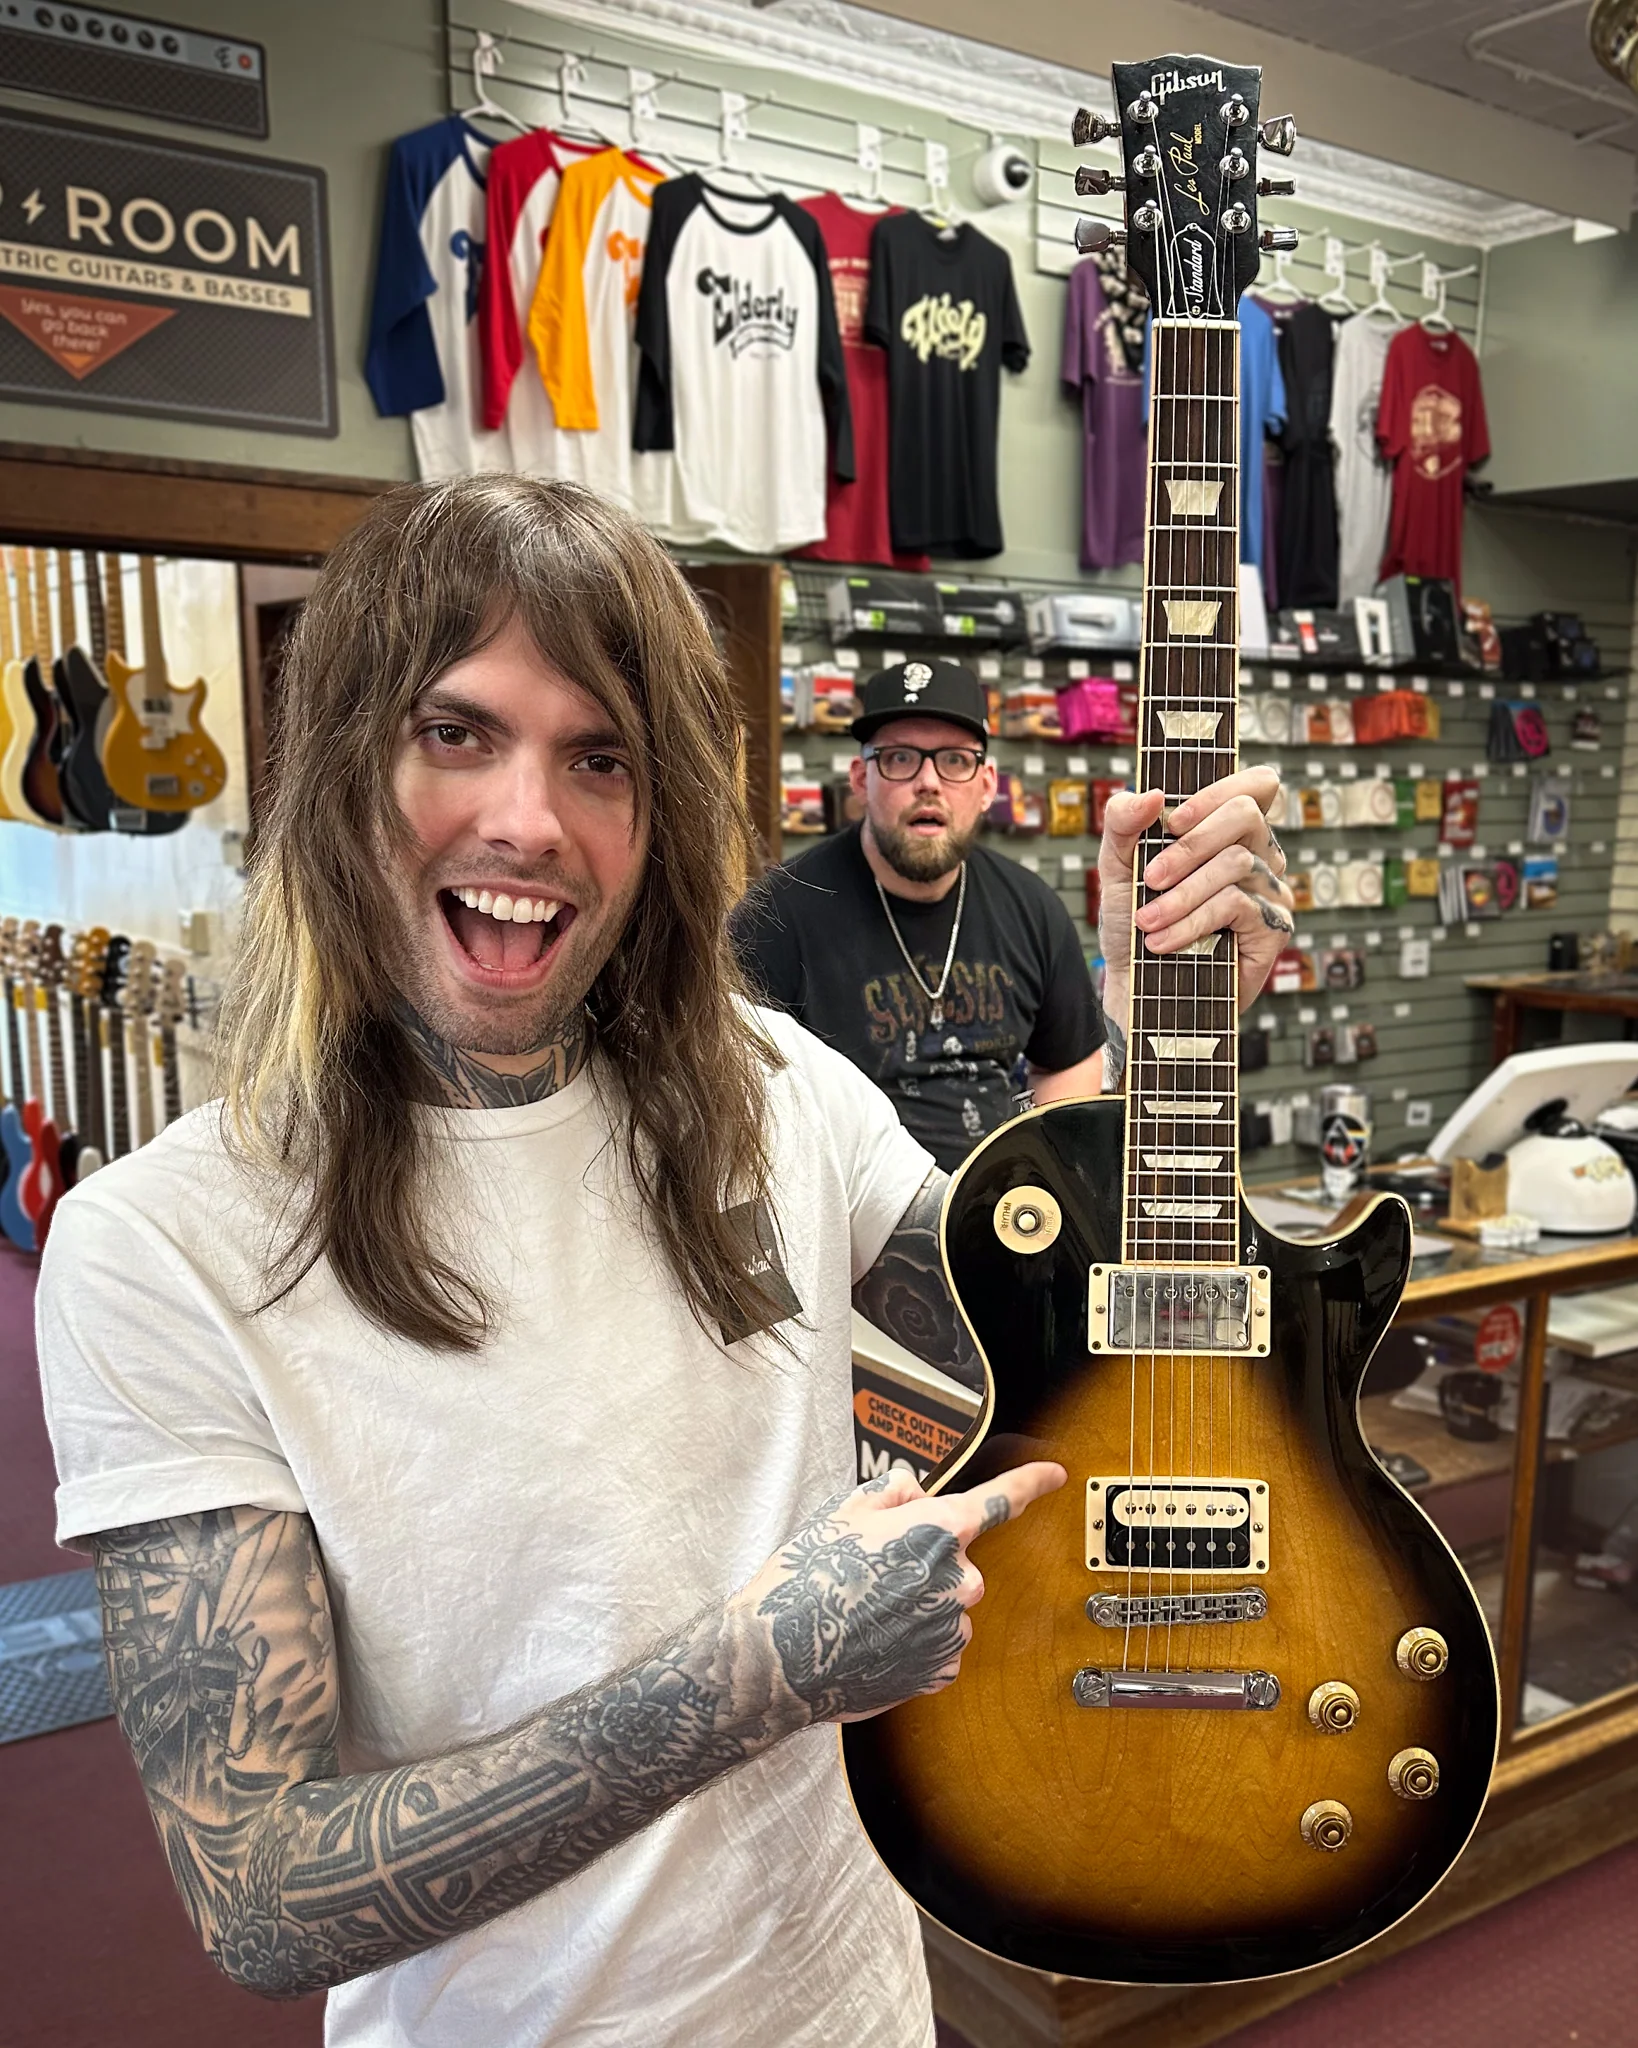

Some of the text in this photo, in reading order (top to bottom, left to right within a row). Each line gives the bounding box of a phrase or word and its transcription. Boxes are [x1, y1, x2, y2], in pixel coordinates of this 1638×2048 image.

[1151, 69, 1227, 106] Gibson
[1194, 122, 1203, 145] MODEL
[1167, 131, 1210, 216] Les Paul
[66, 185, 301, 276] ROOM
[0, 249, 292, 308] TRIC GUITARS & BASSES
[1183, 237, 1204, 303] Standard
[59, 305, 93, 320] you
[95, 309, 128, 326] can
[696, 266, 798, 347] Elderly
[41, 317, 109, 338] go back
[1000, 1201, 1012, 1231] RHYTHM
[867, 1413, 894, 1433] AMP
[896, 1429, 934, 1453] ROOM
[868, 1397, 907, 1424] CHECK
[909, 1416, 935, 1437] OUT
